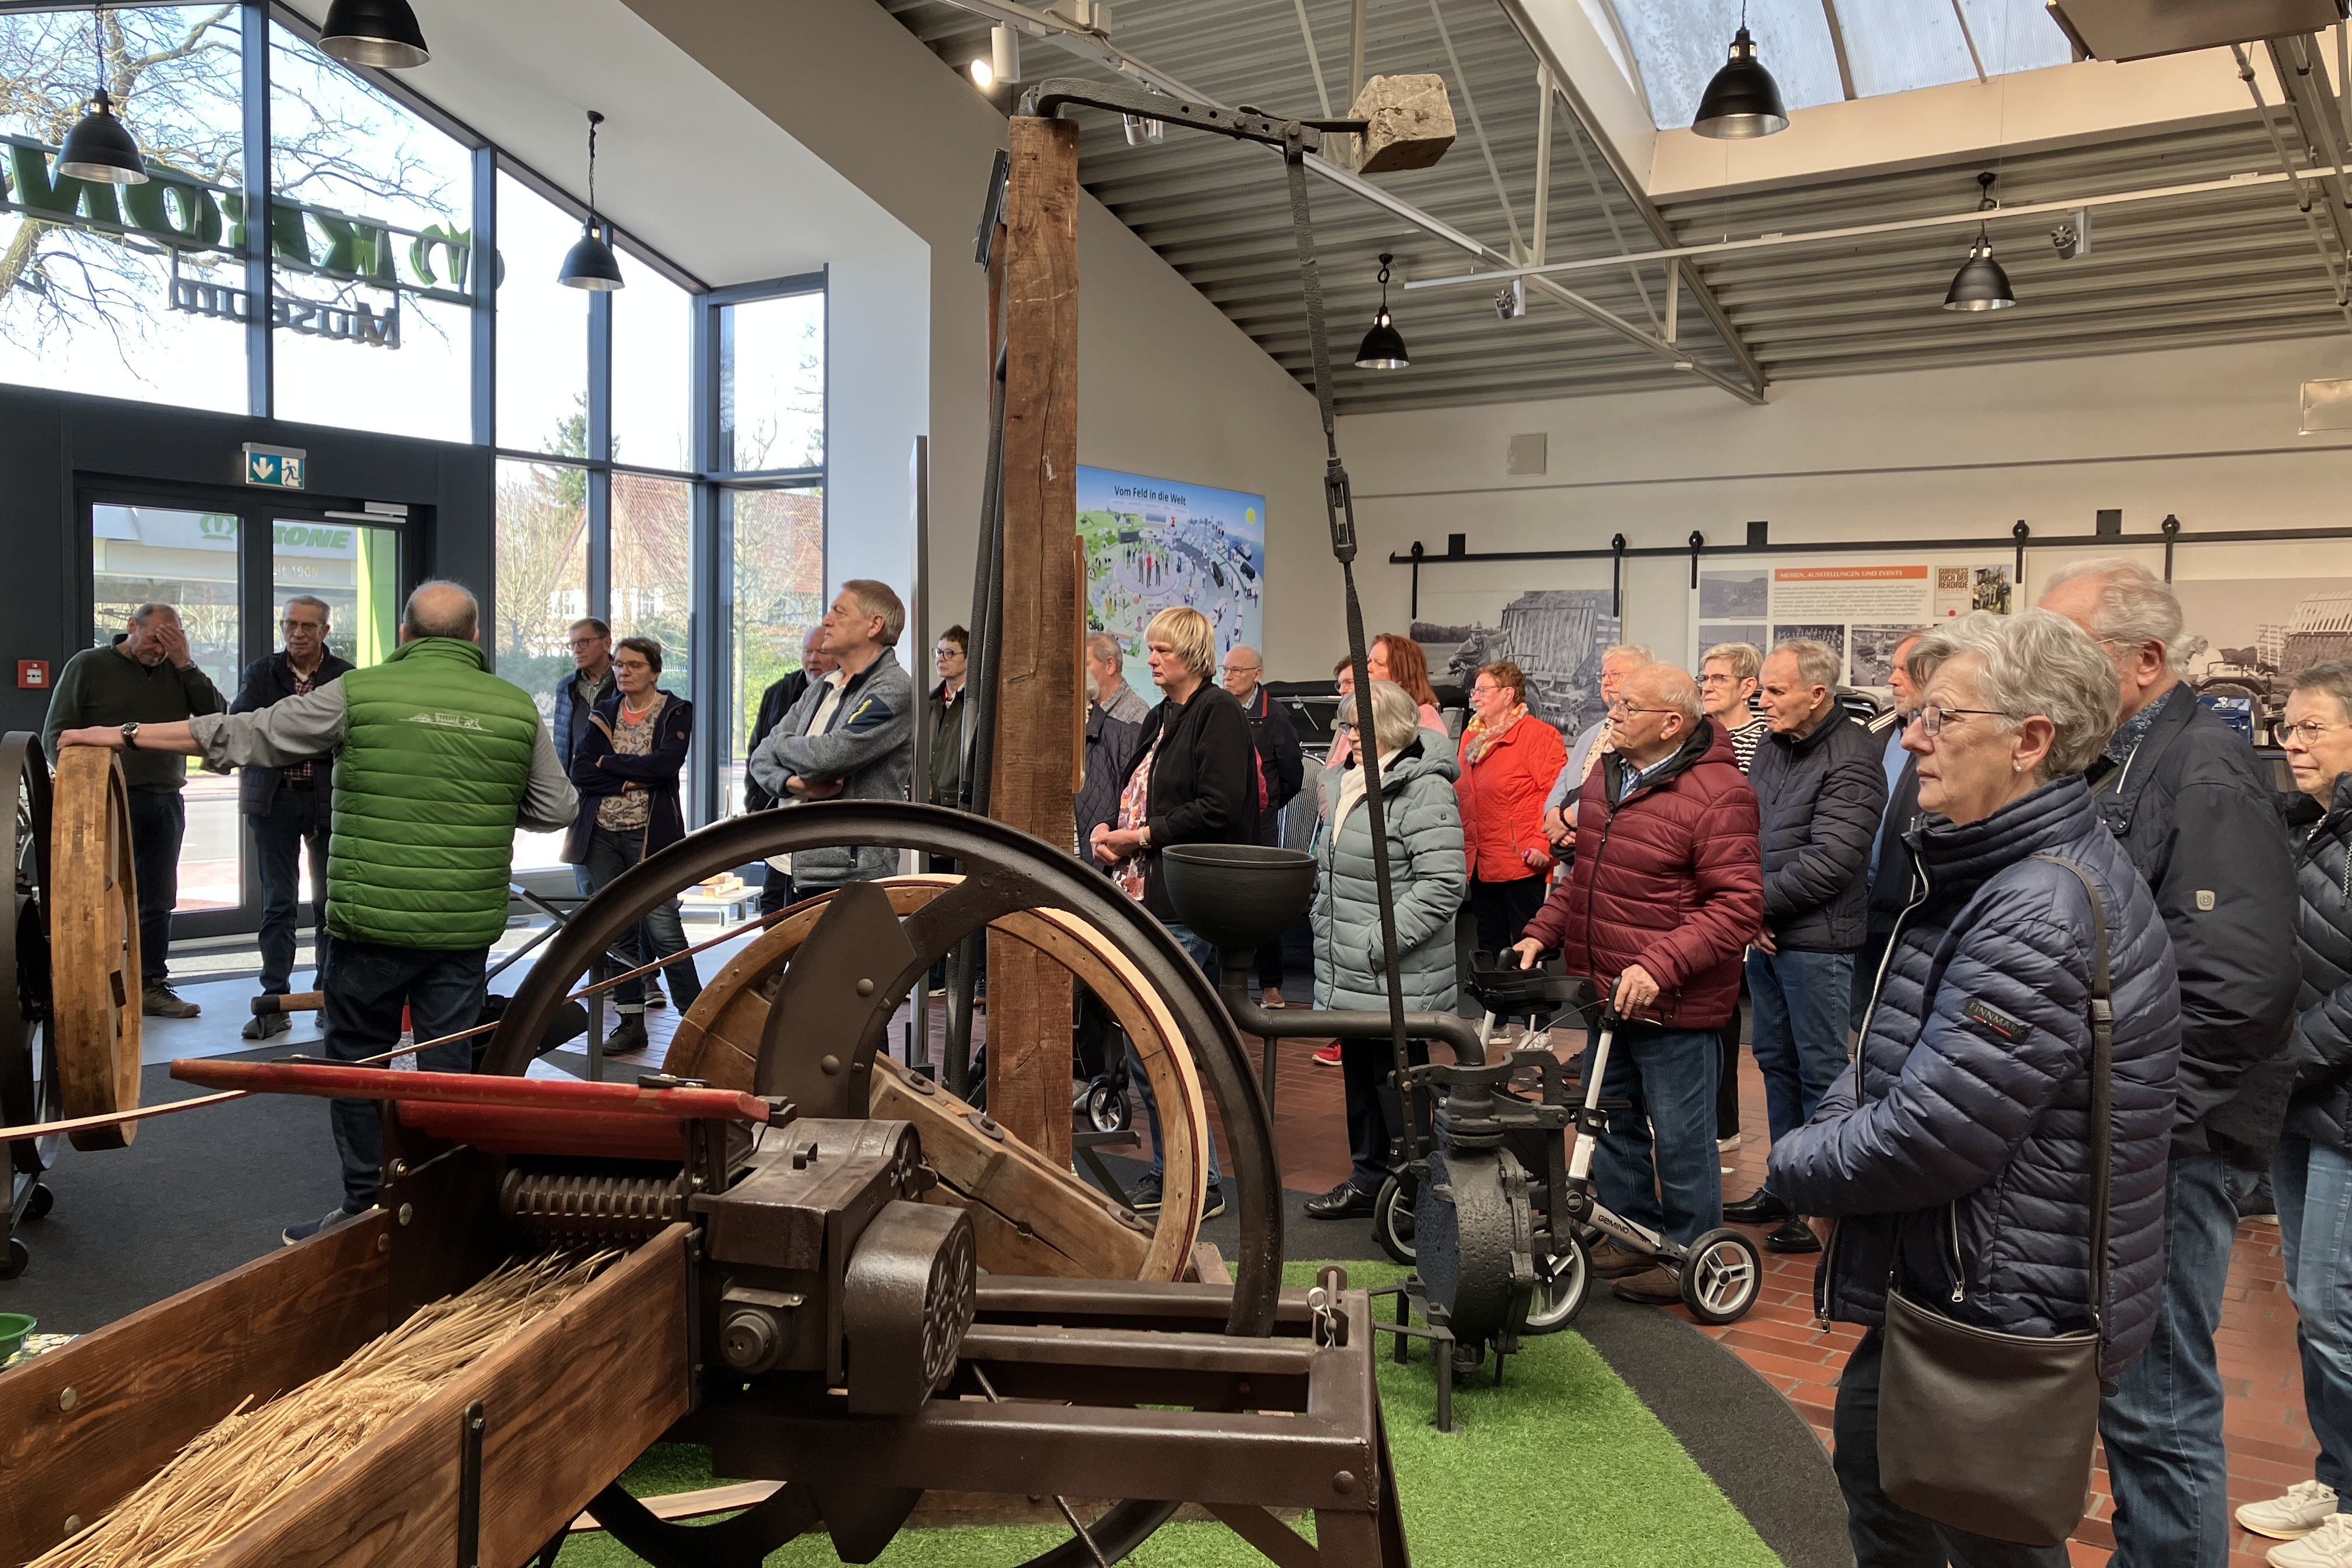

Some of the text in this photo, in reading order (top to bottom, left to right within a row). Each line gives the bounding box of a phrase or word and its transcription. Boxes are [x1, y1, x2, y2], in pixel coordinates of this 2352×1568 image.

[1114, 485, 1186, 506] Vom Feld in die Welt
[290, 565, 318, 578] 1906
[1969, 1002, 2025, 1037] FINNMARK
